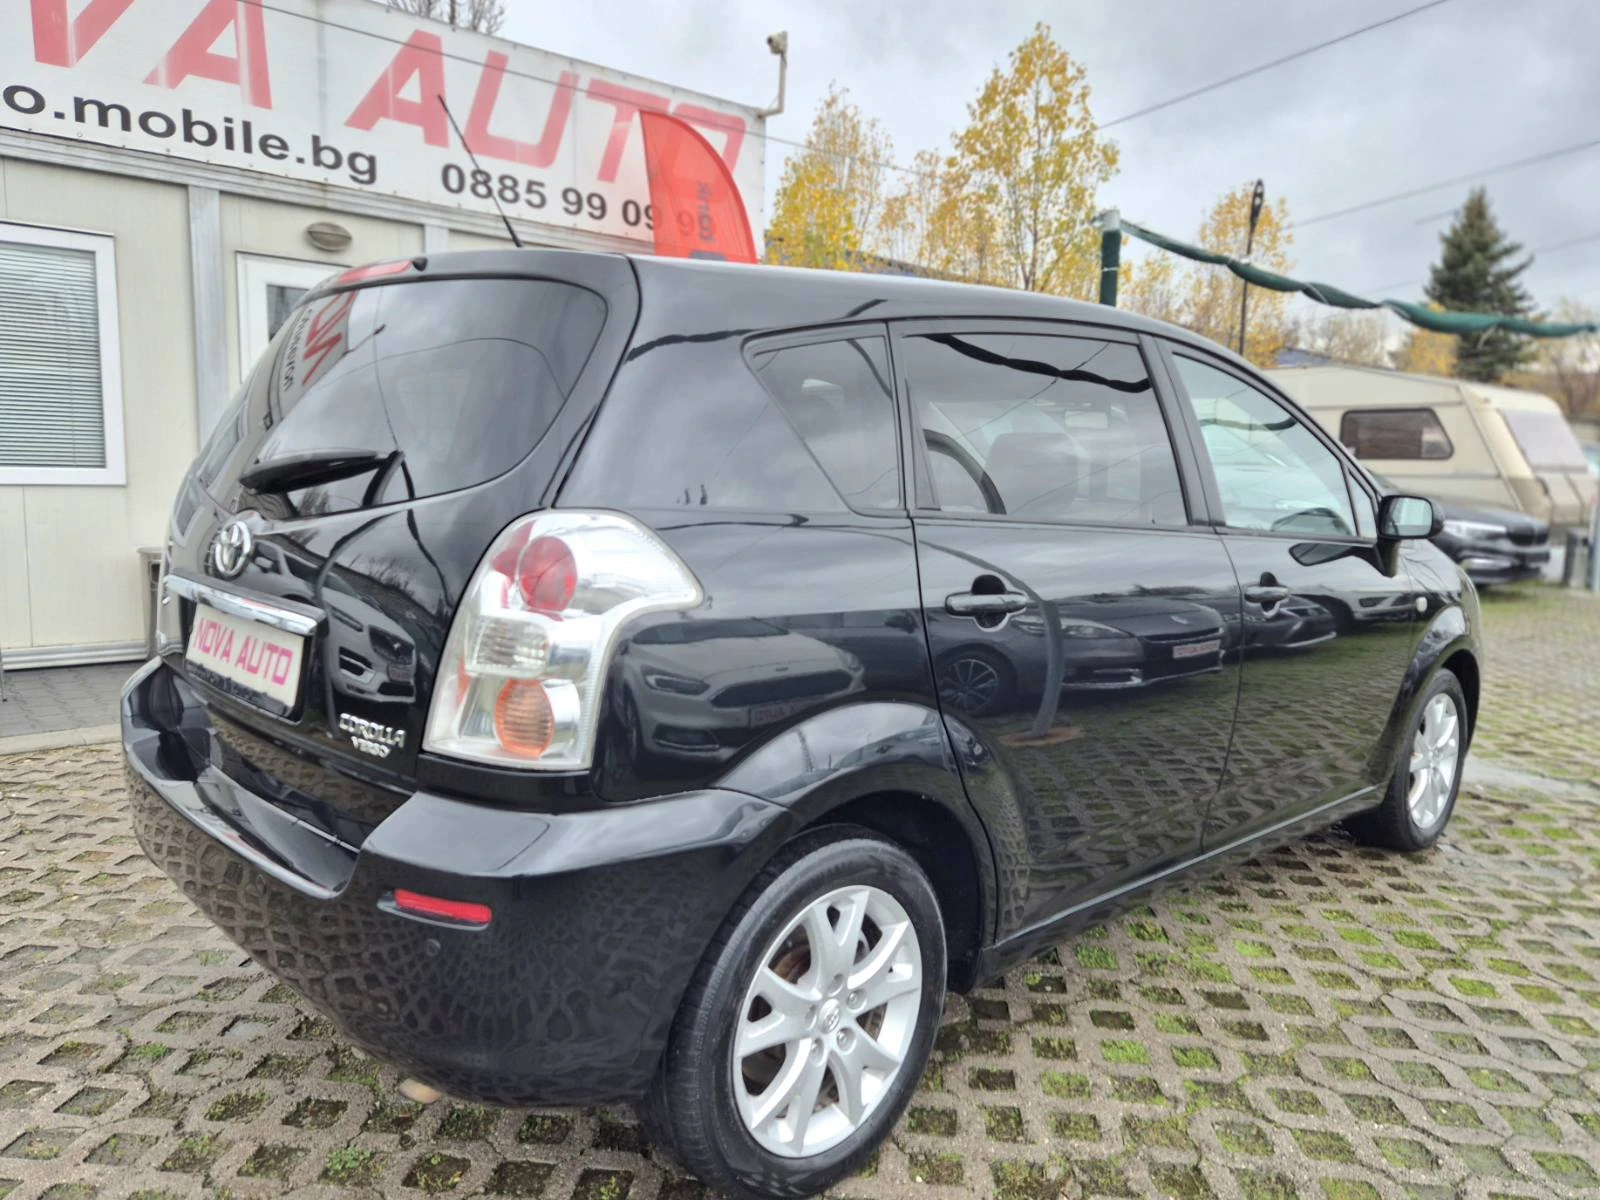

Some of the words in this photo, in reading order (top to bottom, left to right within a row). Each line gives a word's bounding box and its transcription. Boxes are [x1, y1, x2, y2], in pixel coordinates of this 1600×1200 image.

[3, 84, 378, 185] o.mobile.bg
[441, 163, 547, 209] 0885
[561, 187, 608, 221] 99
[193, 617, 236, 664] NOVA
[234, 634, 294, 686] AUTO
